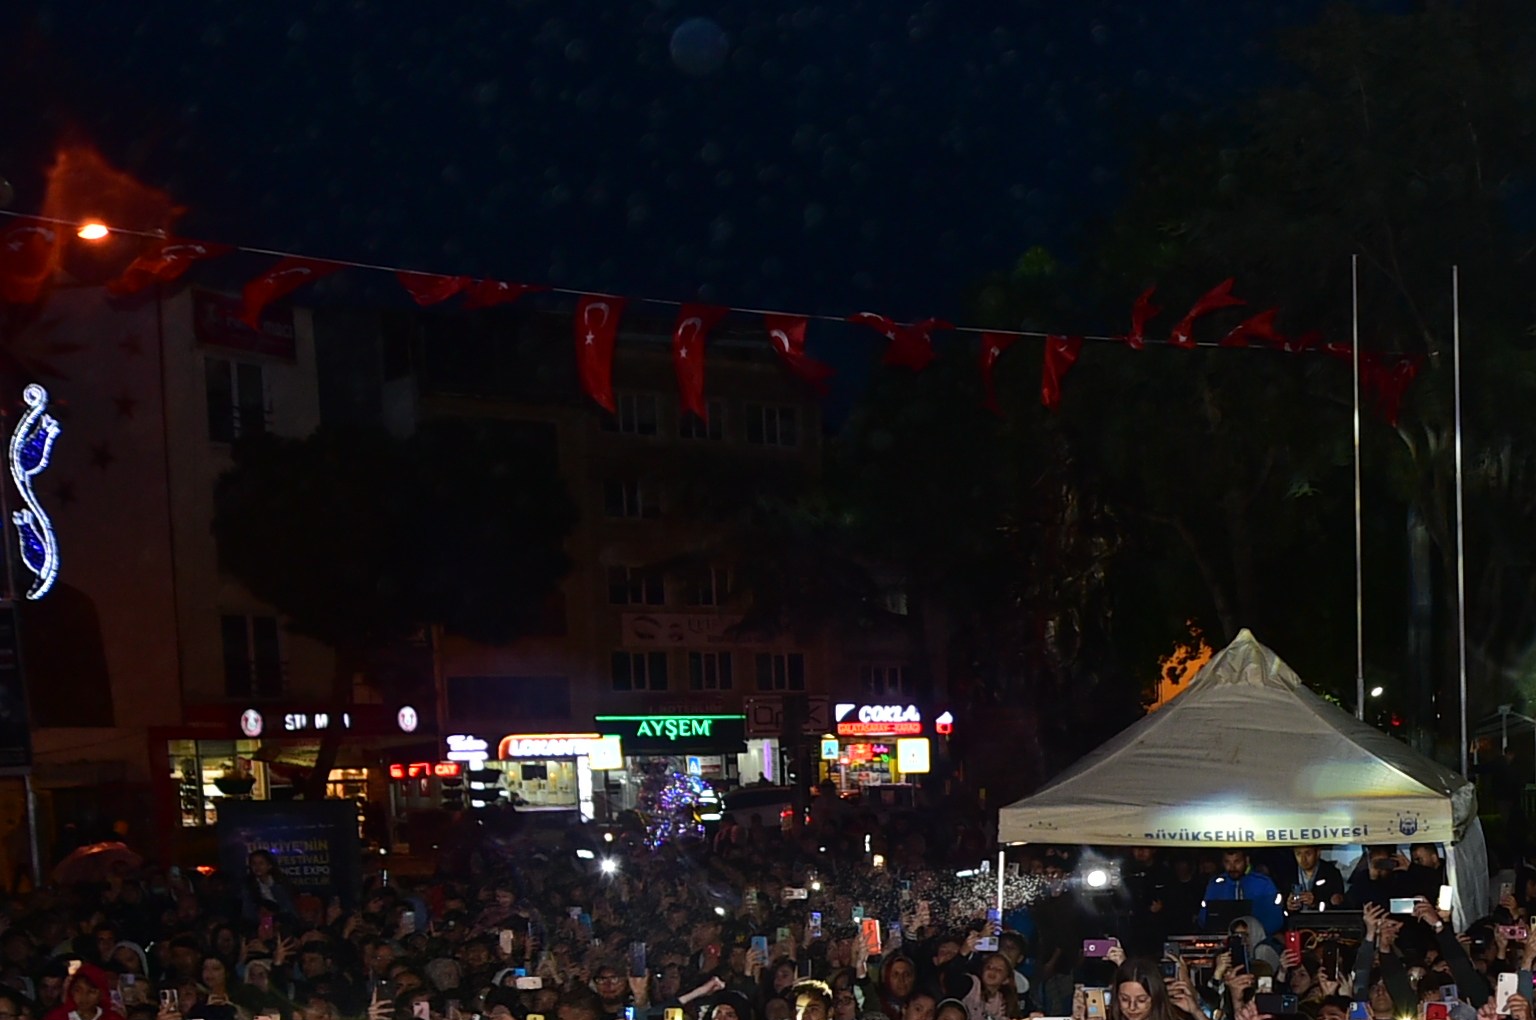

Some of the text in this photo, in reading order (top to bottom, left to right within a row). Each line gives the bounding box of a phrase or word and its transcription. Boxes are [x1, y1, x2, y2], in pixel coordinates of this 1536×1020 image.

[637, 719, 711, 741] AYŞEM
[1266, 824, 1369, 841] BELEDİYESİ
[304, 866, 330, 875] EXPO
